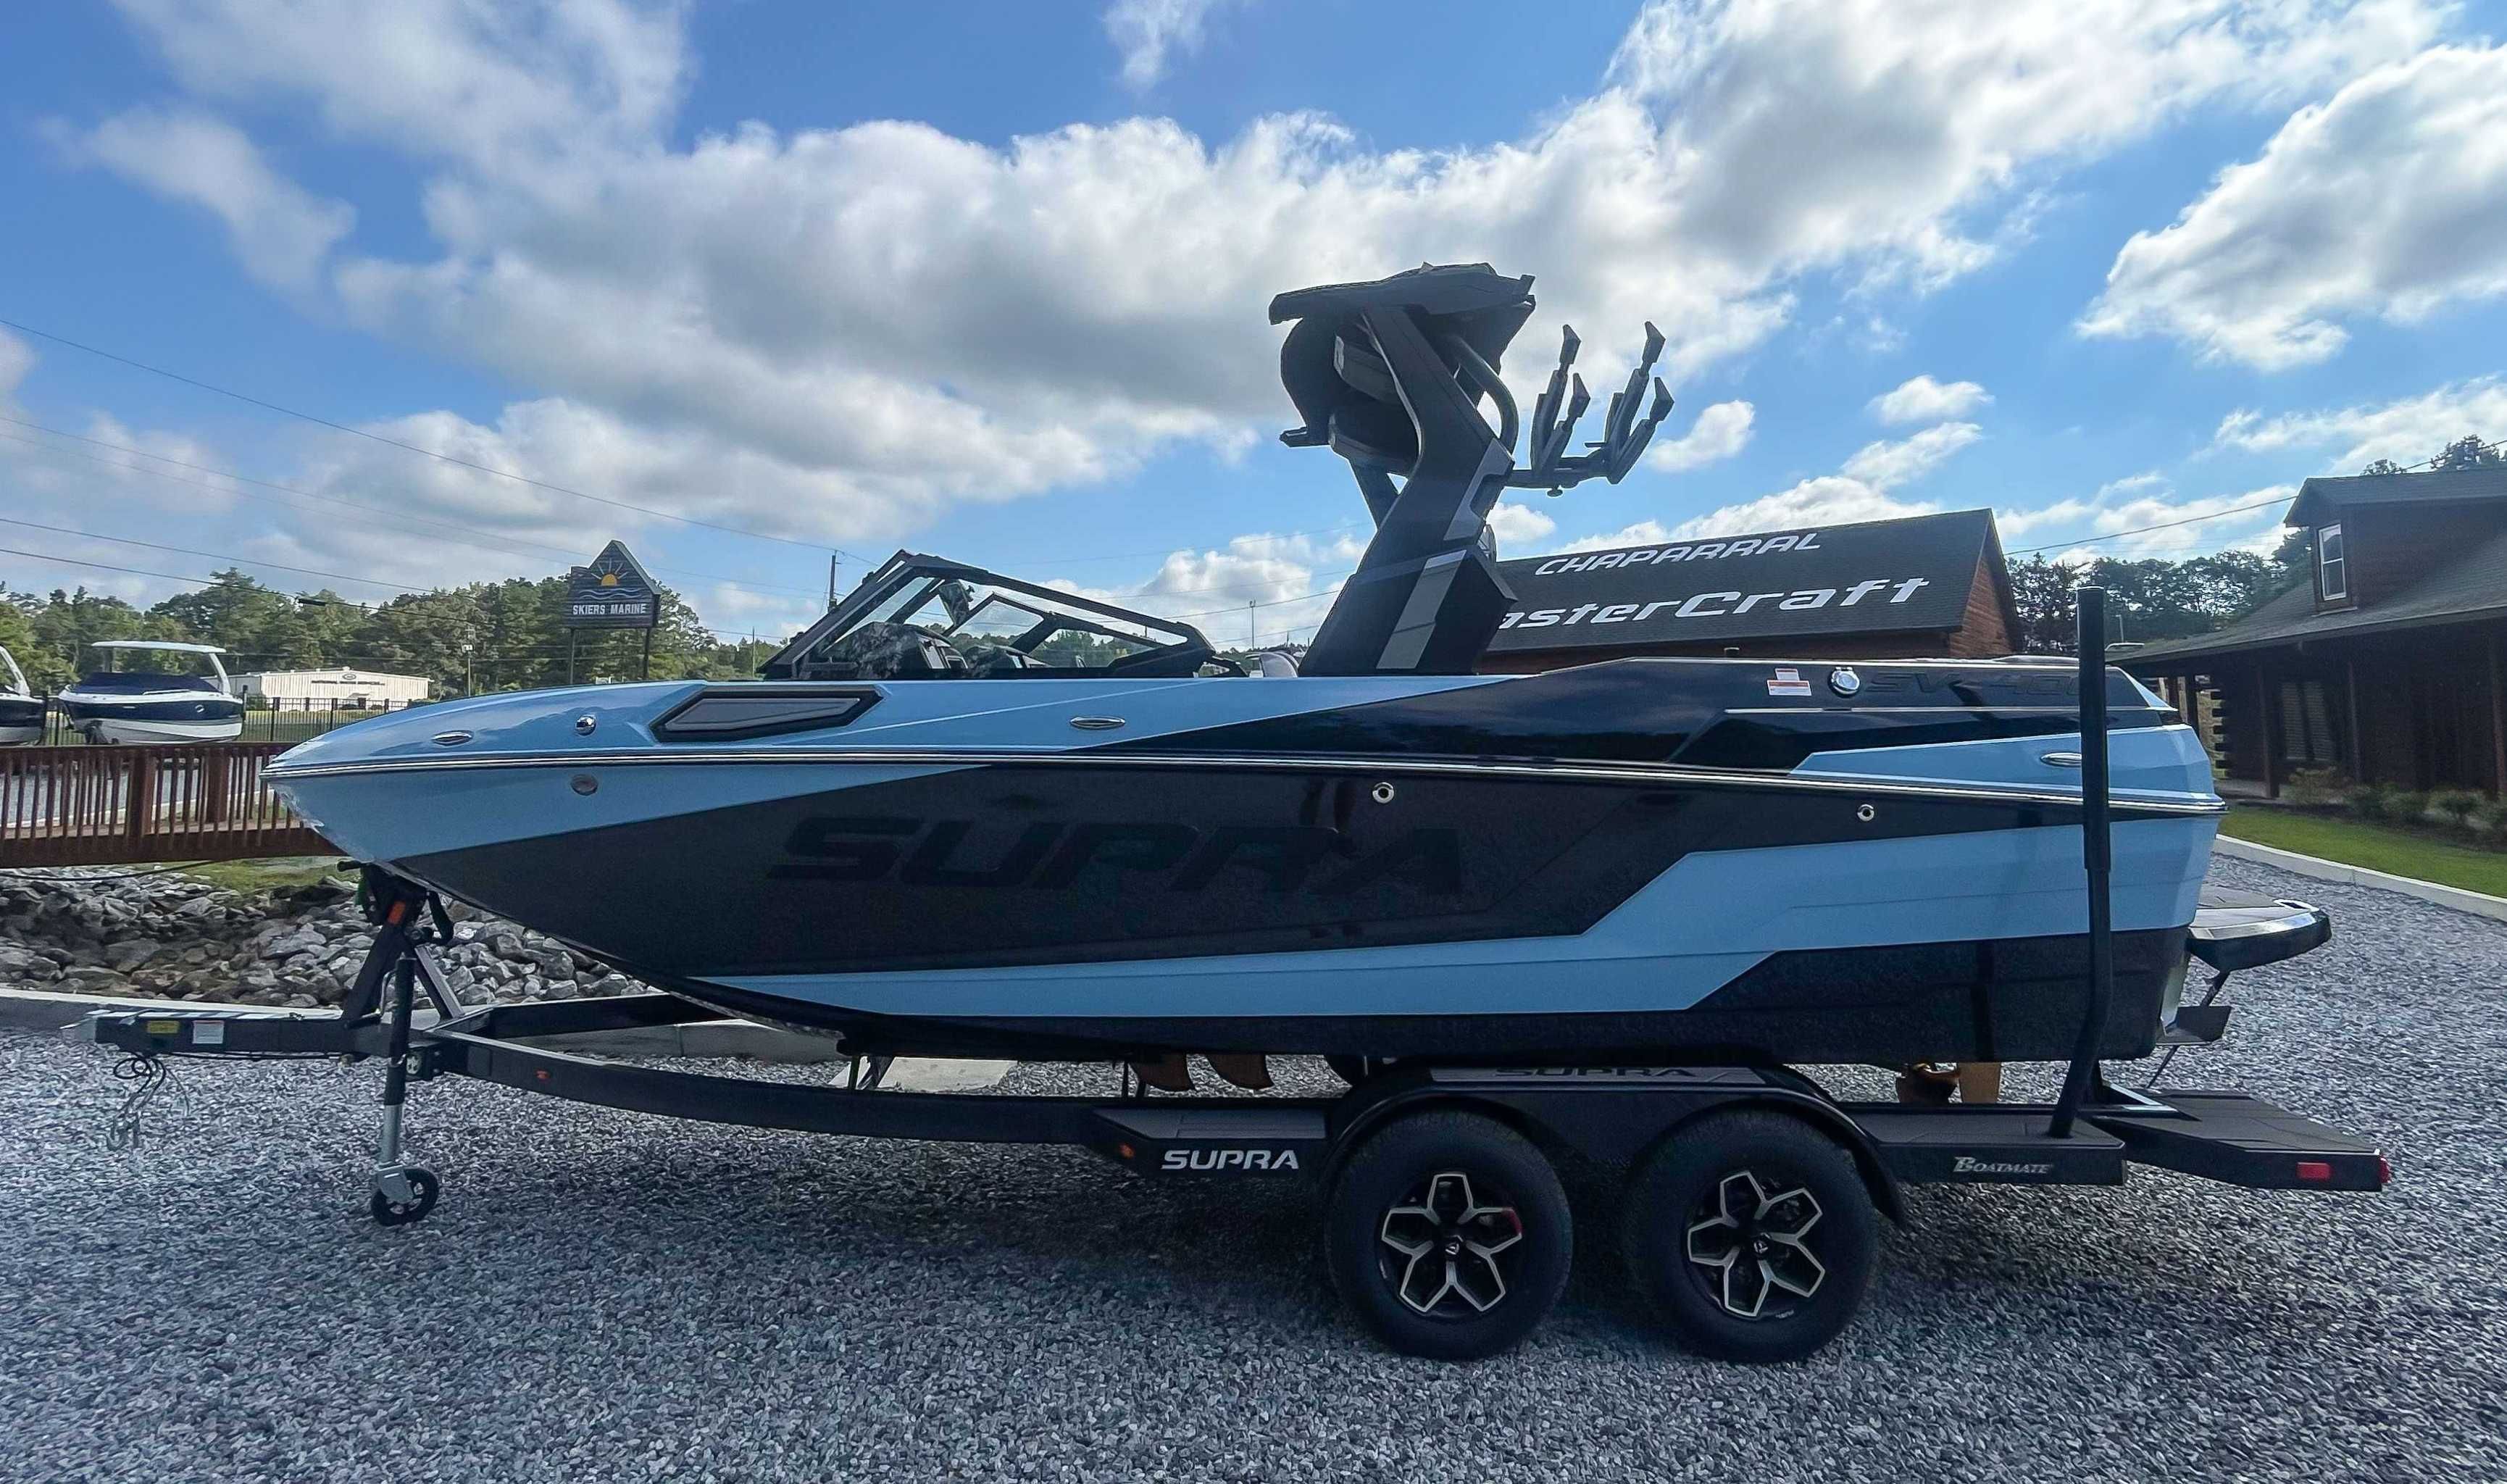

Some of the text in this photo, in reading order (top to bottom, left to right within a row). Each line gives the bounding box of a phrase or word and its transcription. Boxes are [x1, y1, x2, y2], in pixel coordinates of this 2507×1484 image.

[1535, 532, 1822, 576] CHAPARRAL
[572, 603, 648, 615] SKIERS MARINE
[1498, 578, 1930, 630] sterCraft
[768, 816, 1463, 896] SUPRA
[1494, 1067, 1696, 1077] SUPRA
[1161, 1149, 1300, 1170] SUPRA
